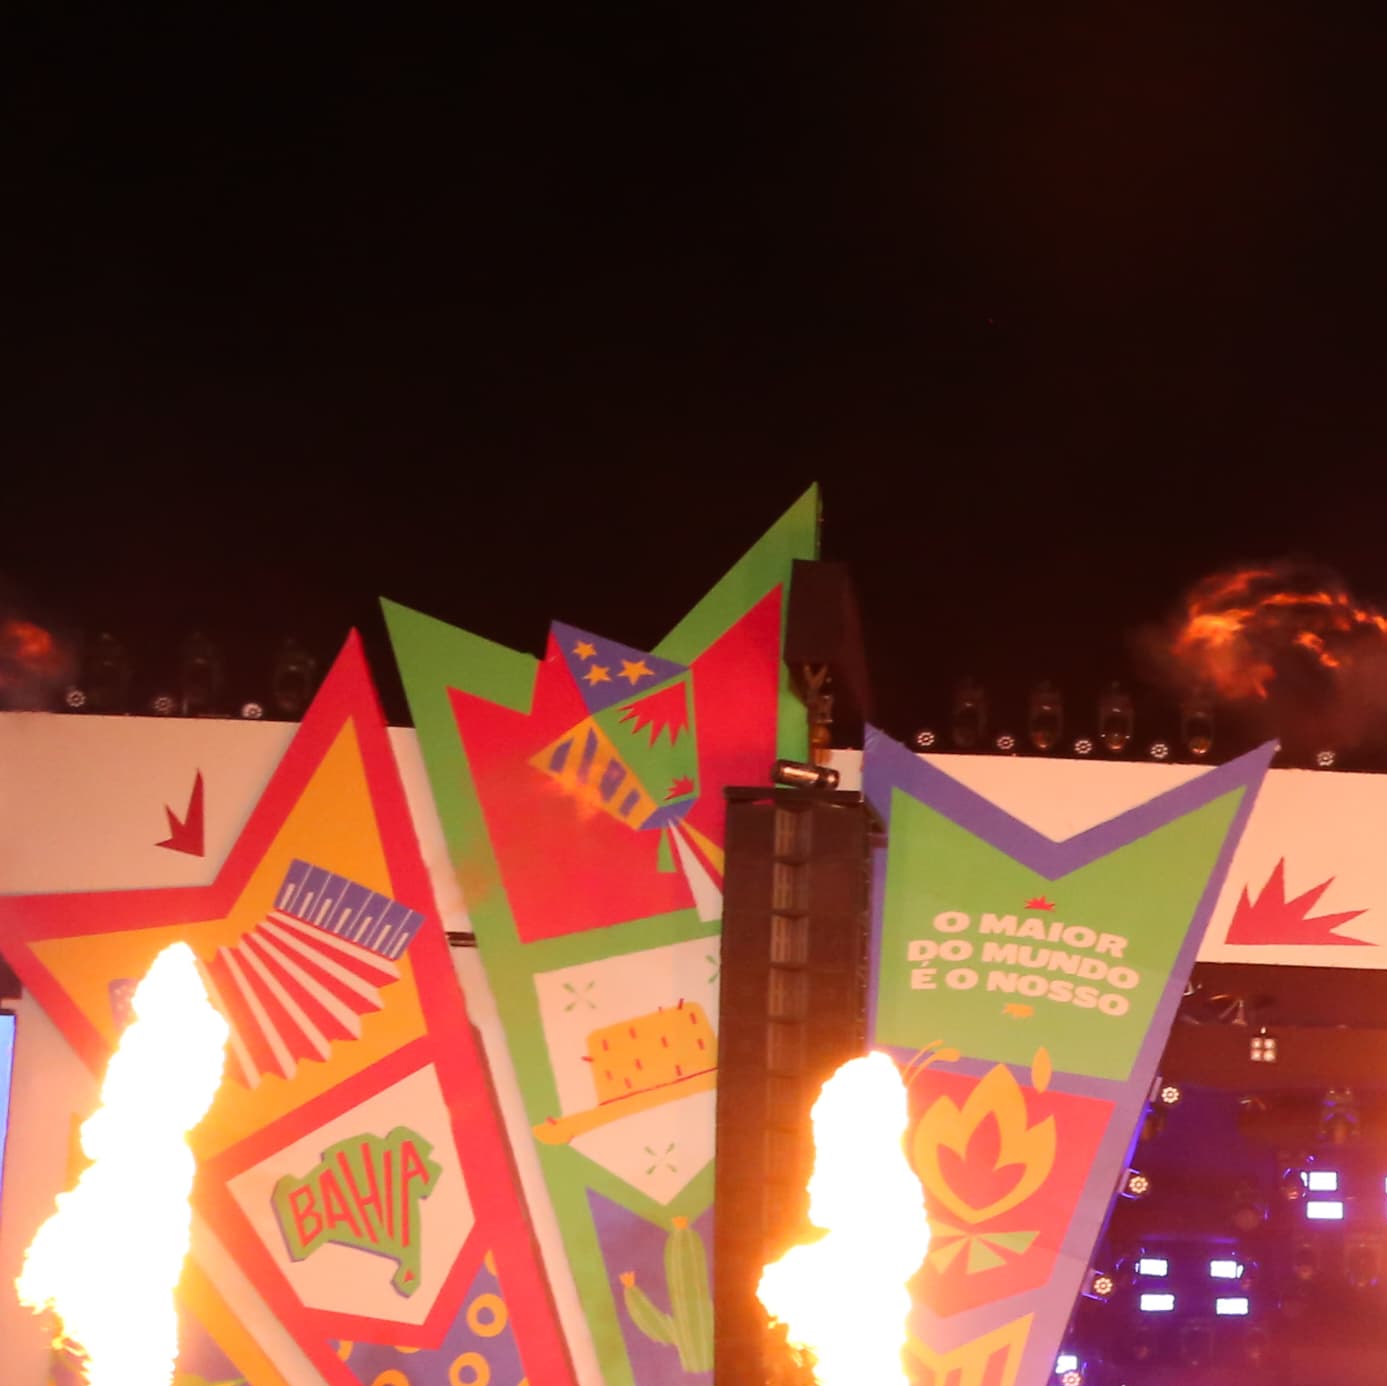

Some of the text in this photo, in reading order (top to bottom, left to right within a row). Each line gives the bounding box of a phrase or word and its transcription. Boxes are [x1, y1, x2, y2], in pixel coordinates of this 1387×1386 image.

[933, 911, 1128, 958] O MAIOR
[907, 940, 1140, 989] DO MUNDO
[910, 960, 1130, 1016] É O NOSSO
[288, 1140, 430, 1248] BAHIA
